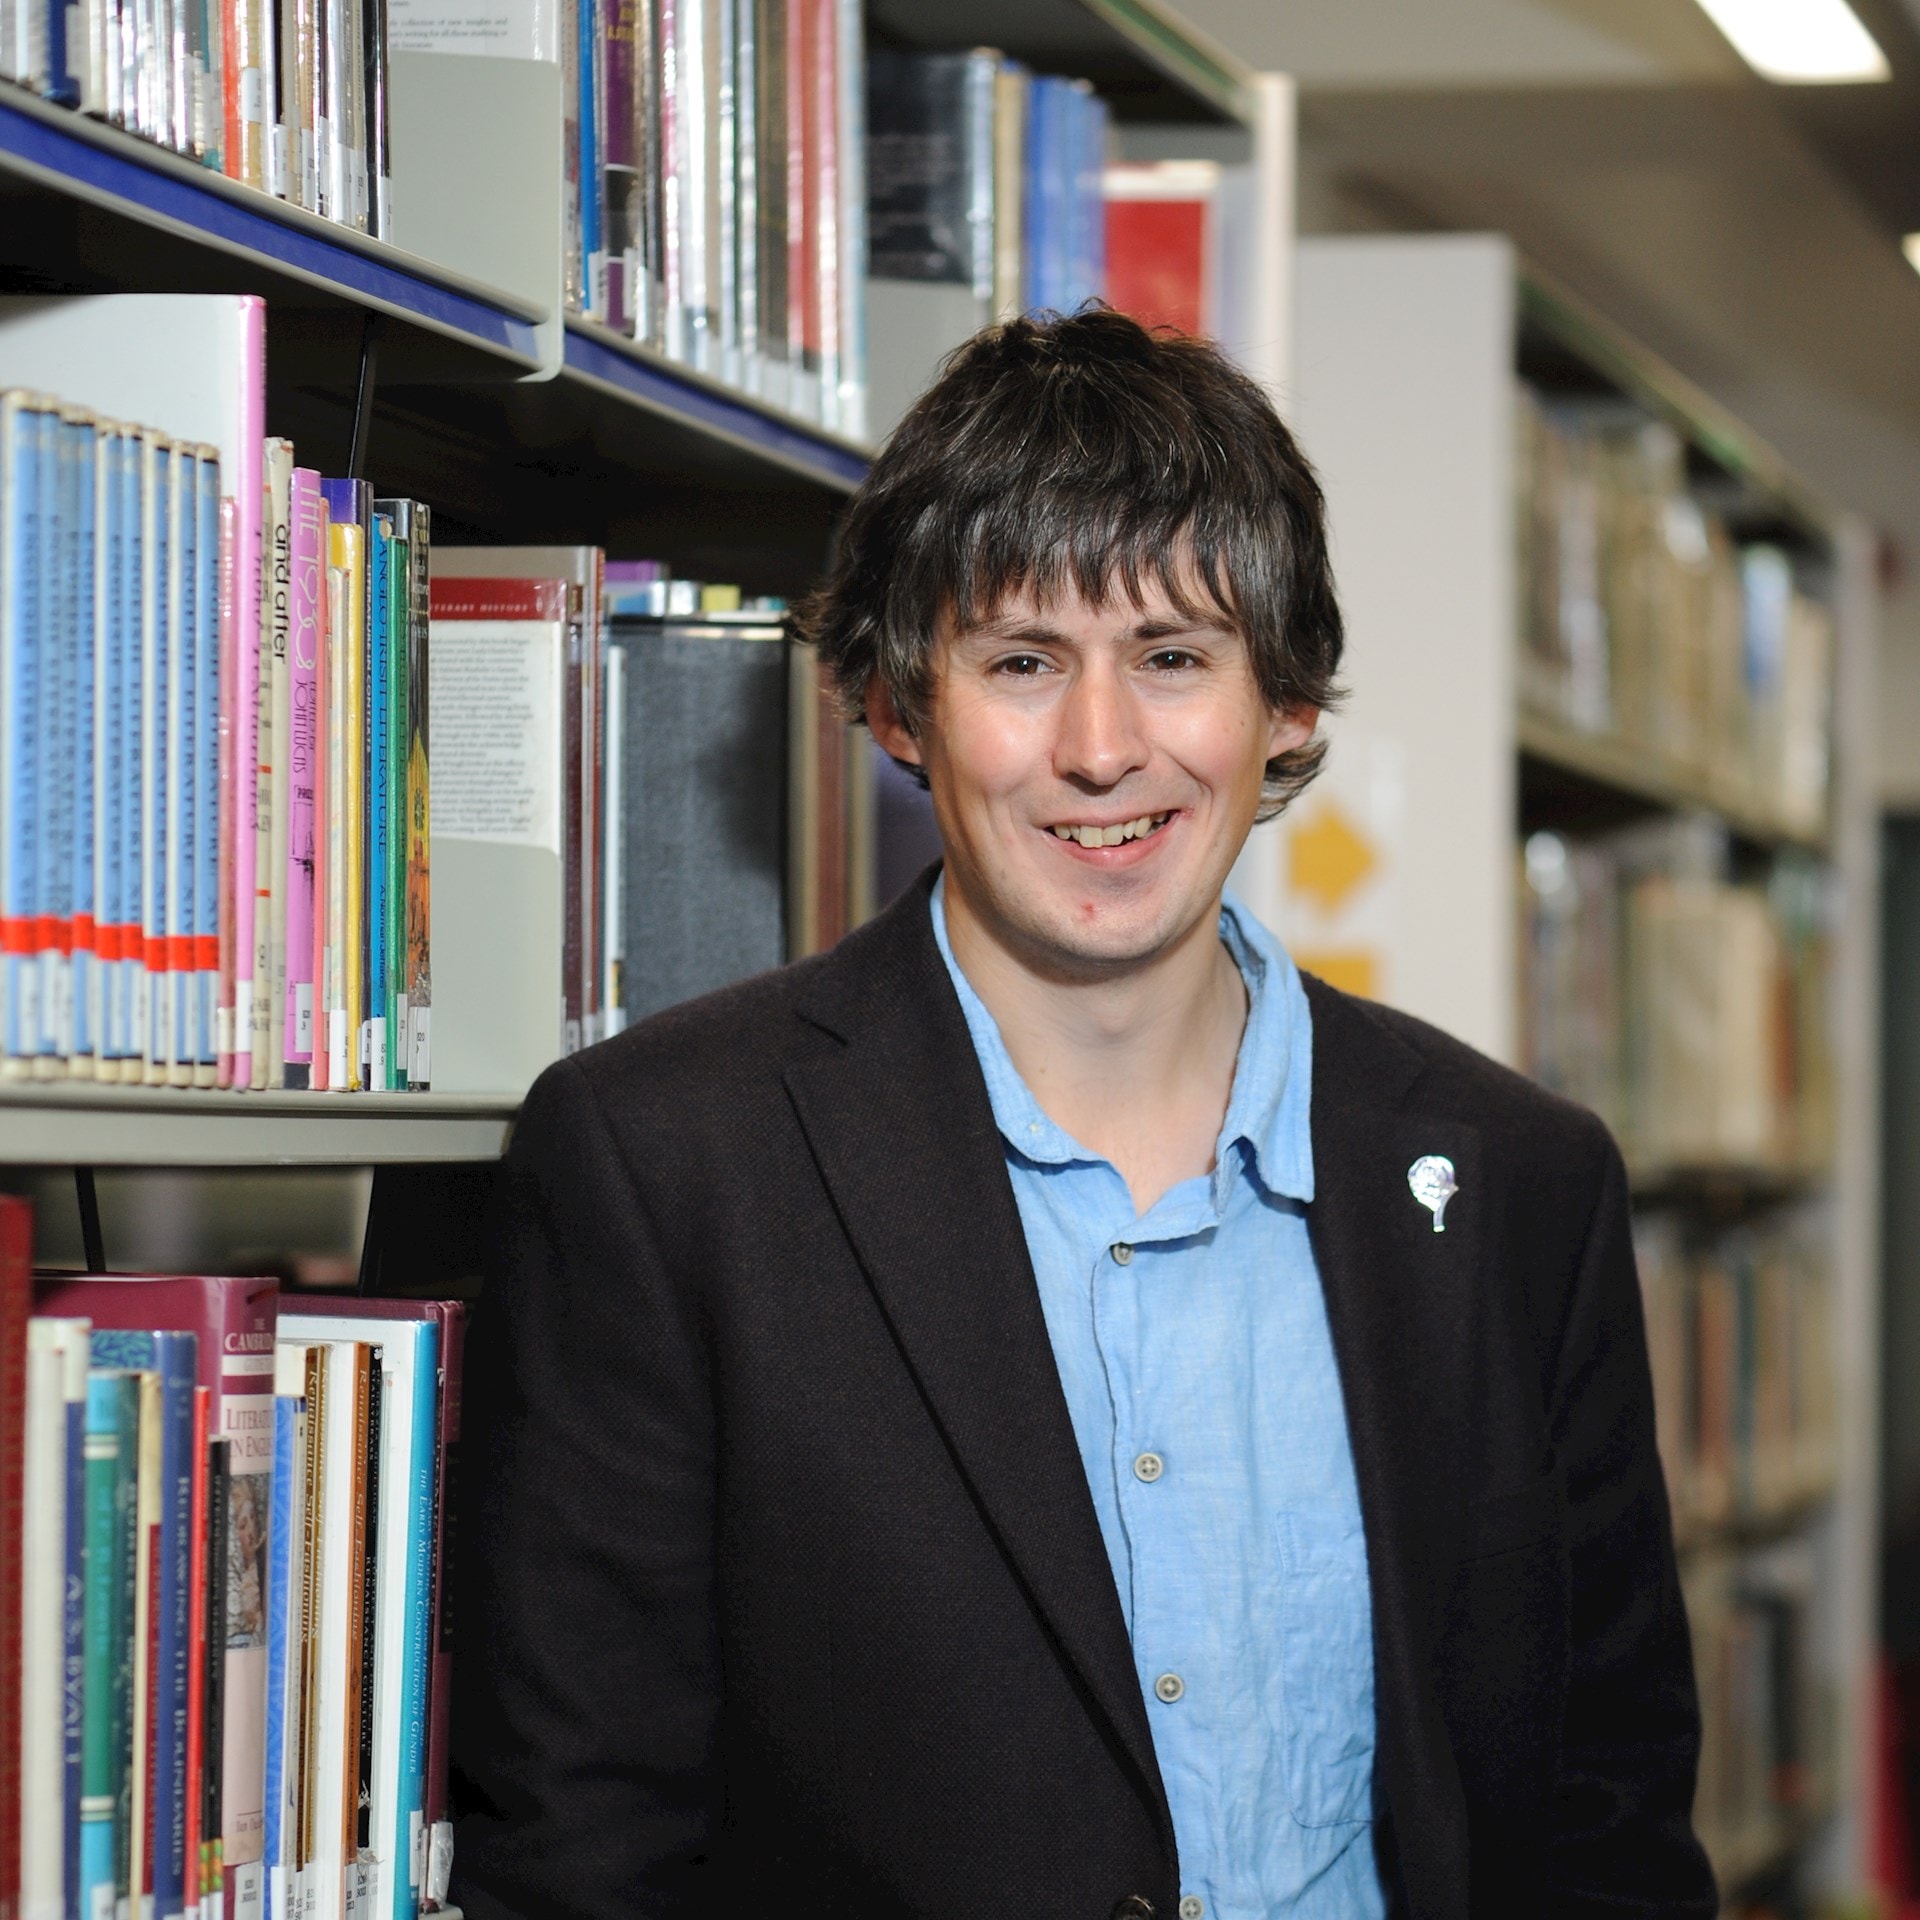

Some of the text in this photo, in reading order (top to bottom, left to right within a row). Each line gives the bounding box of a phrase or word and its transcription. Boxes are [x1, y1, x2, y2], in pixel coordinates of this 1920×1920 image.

[299, 486, 320, 539] THE
[274, 524, 290, 665] and after
[431, 603, 475, 613] TERARY
[225, 1333, 275, 1352] CAMBRID
[307, 1370, 318, 1486] Renaissance
[356, 1368, 368, 1484] Renaissance
[300, 1493, 314, 1643] Self-Fashioning
[353, 1492, 363, 1641] Self-Fashioning
[408, 1467, 429, 1774] THE EARLY MODERN CONSTRUCTION OF GENDER
[360, 1556, 371, 1751] RENAISSANCE CULTURE
